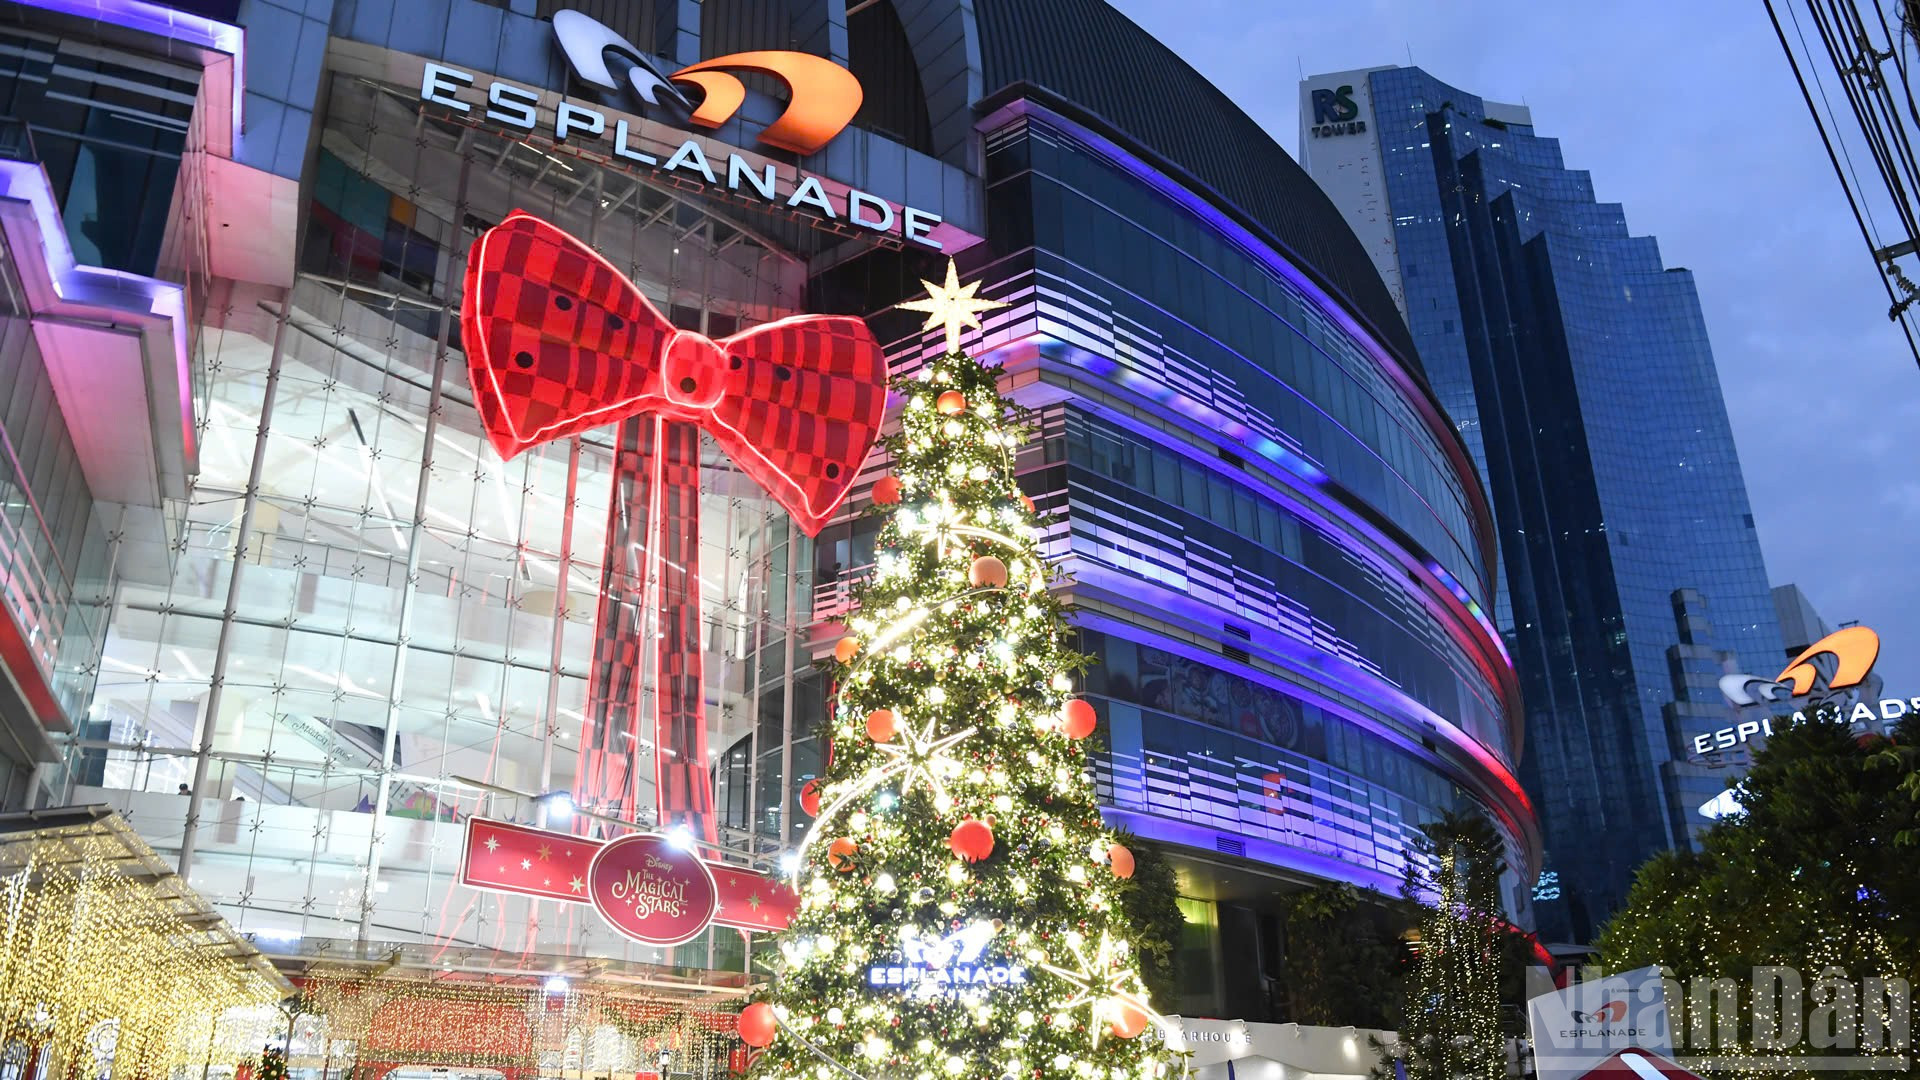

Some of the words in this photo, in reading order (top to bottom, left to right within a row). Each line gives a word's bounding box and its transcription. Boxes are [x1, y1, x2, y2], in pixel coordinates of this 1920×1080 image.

[1312, 85, 1358, 124] RS
[1311, 121, 1367, 139] TOWER
[421, 62, 943, 250] ESPLANADE
[611, 869, 689, 903] MAGICAL
[635, 893, 680, 920] STARS
[870, 966, 1026, 985] ESPLANADE
[1158, 1028, 1252, 1045] BARHOUE
[1559, 1028, 1647, 1039] ESPLANADE
